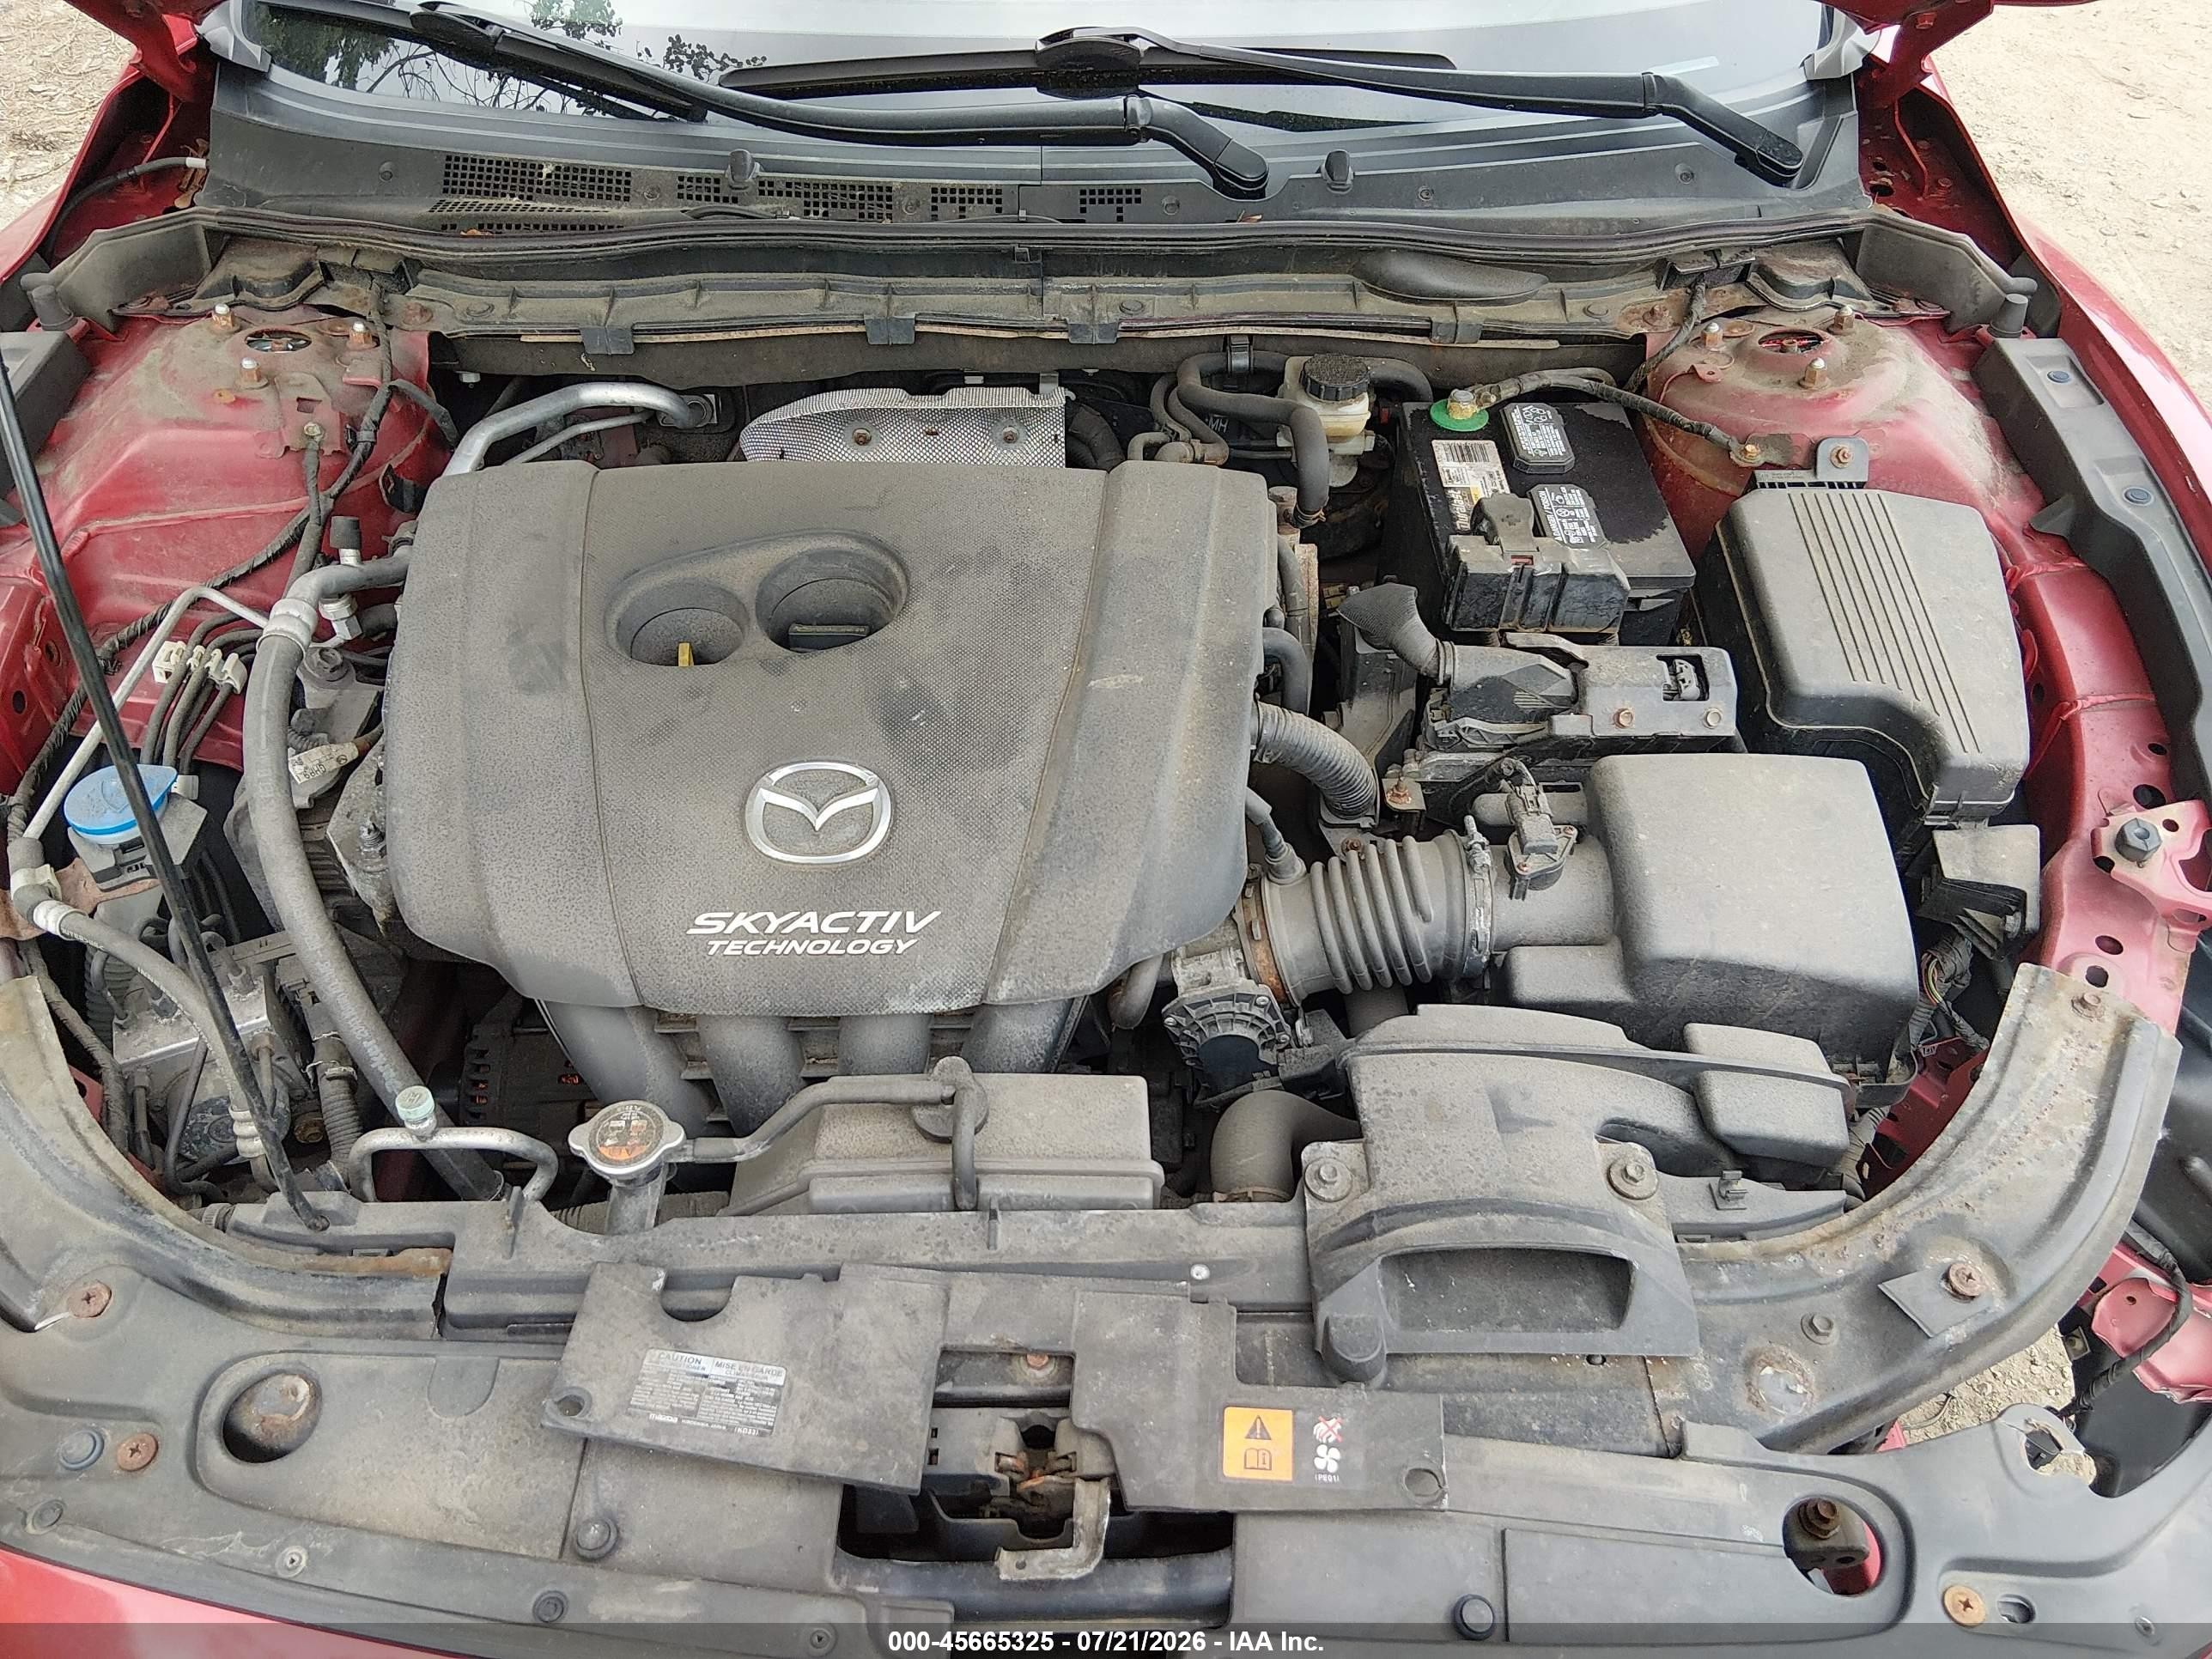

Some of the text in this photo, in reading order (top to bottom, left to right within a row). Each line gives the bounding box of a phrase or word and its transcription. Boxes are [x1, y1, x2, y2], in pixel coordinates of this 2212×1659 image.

[1450, 488, 1472, 532] Duralast
[686, 910, 942, 935] SKYACTIV
[707, 939, 920, 956] TECHNOLOGY
[658, 1352, 702, 1365] CAUTION
[714, 1360, 736, 1370] MISE
